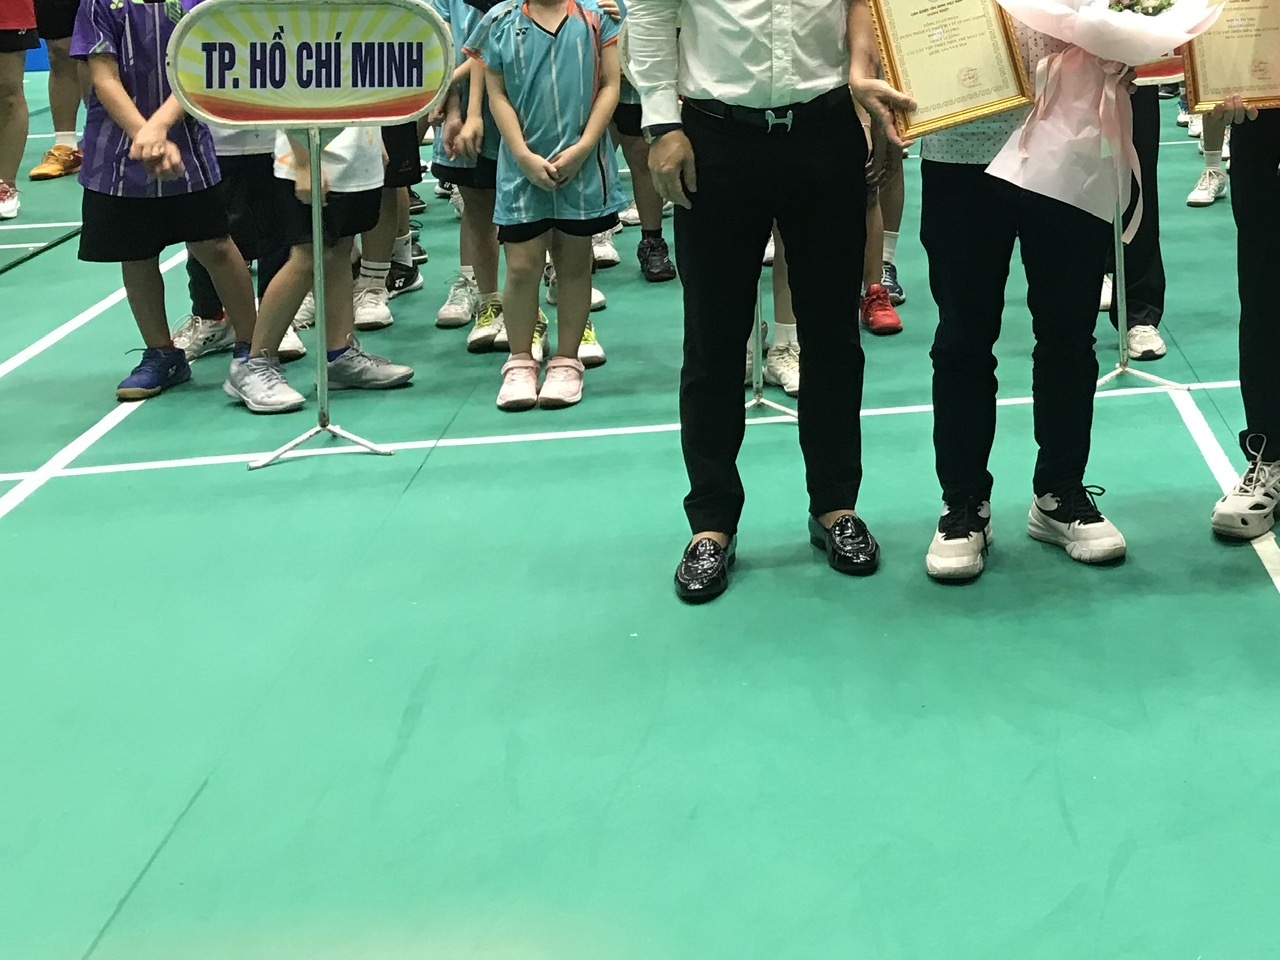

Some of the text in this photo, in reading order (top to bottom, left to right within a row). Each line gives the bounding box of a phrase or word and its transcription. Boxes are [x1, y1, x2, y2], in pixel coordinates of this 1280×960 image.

[201, 26, 424, 90] TP. HỒ CHÍ MINH
